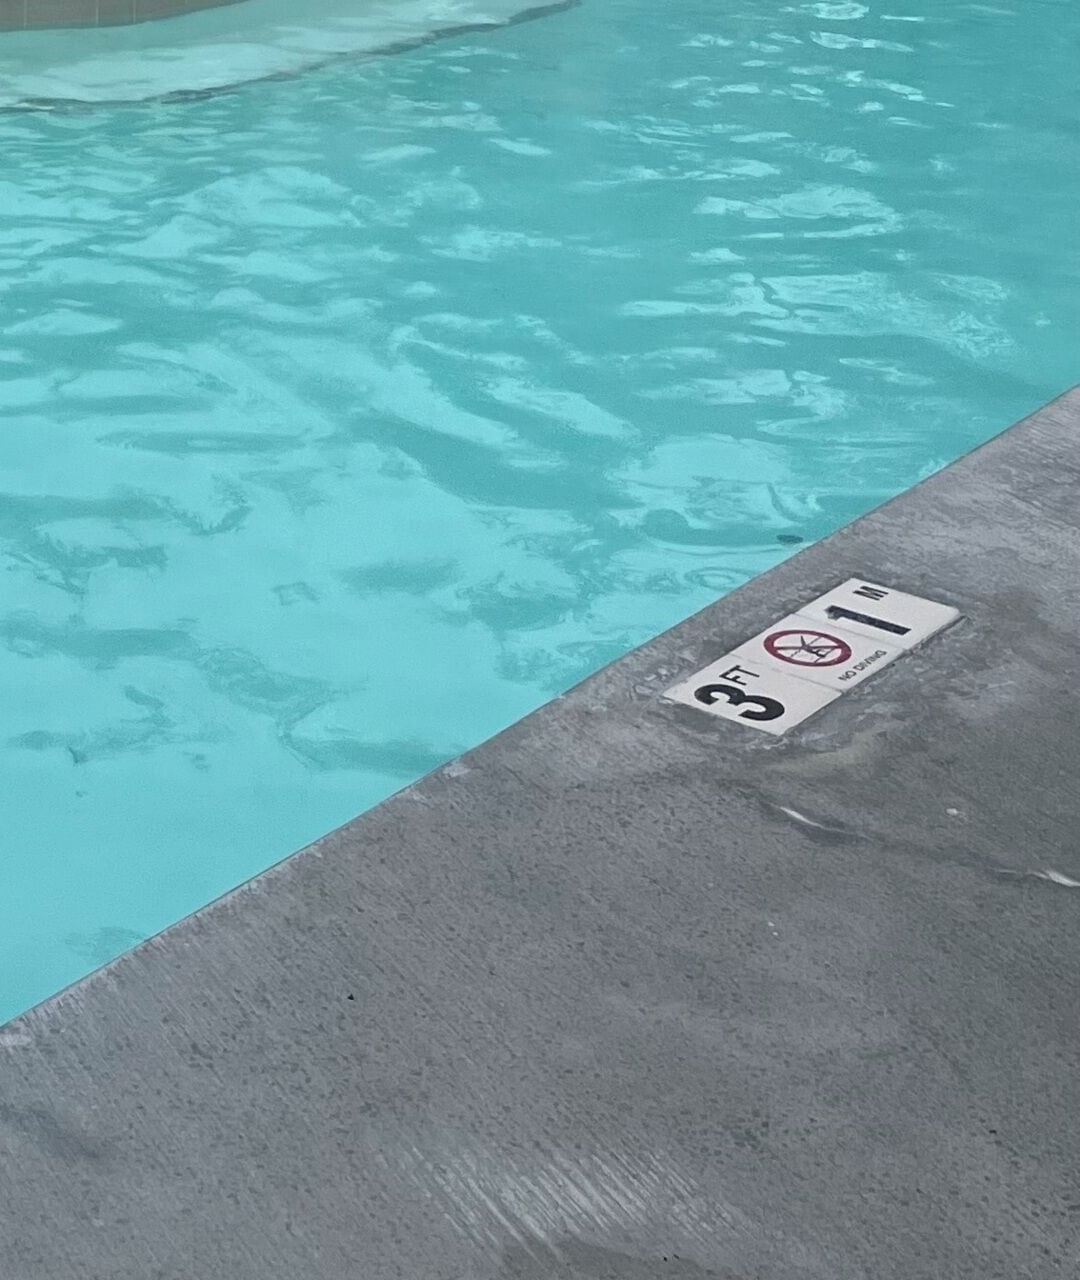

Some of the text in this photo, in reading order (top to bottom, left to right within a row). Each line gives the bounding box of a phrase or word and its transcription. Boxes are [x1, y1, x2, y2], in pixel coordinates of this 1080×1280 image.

[694, 585, 912, 721] 3 FT 1 M
[838, 649, 888, 681] NO DIVING
